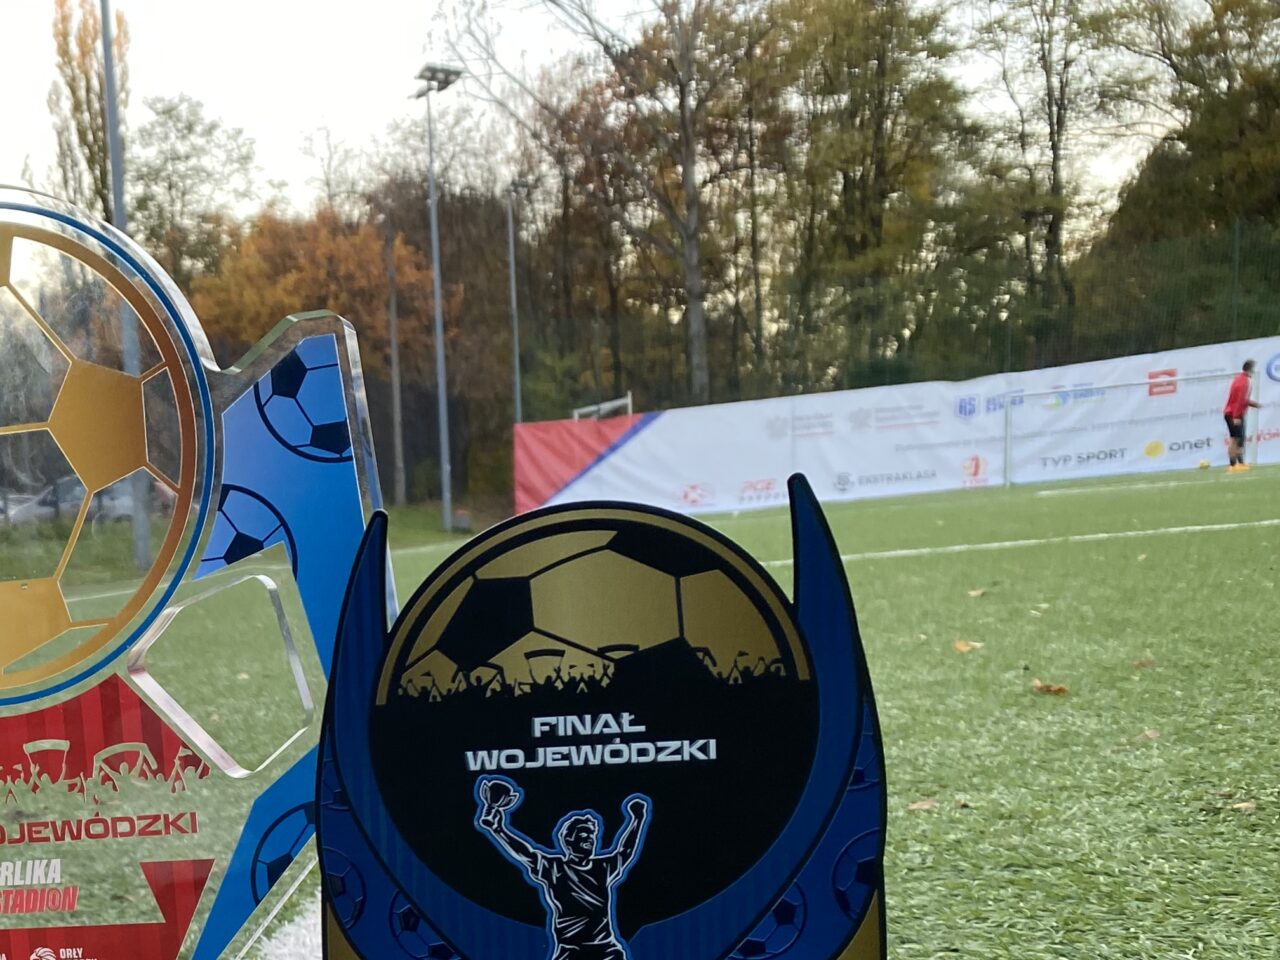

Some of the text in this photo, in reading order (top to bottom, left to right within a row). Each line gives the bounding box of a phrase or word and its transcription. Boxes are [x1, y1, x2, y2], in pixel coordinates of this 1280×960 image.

[1169, 437, 1212, 451] onet
[1077, 448, 1127, 463] SPORT
[531, 712, 646, 737] FINAŁ
[465, 737, 717, 771] WOJEWÓDZKI
[59, 948, 83, 959] ORŁY
